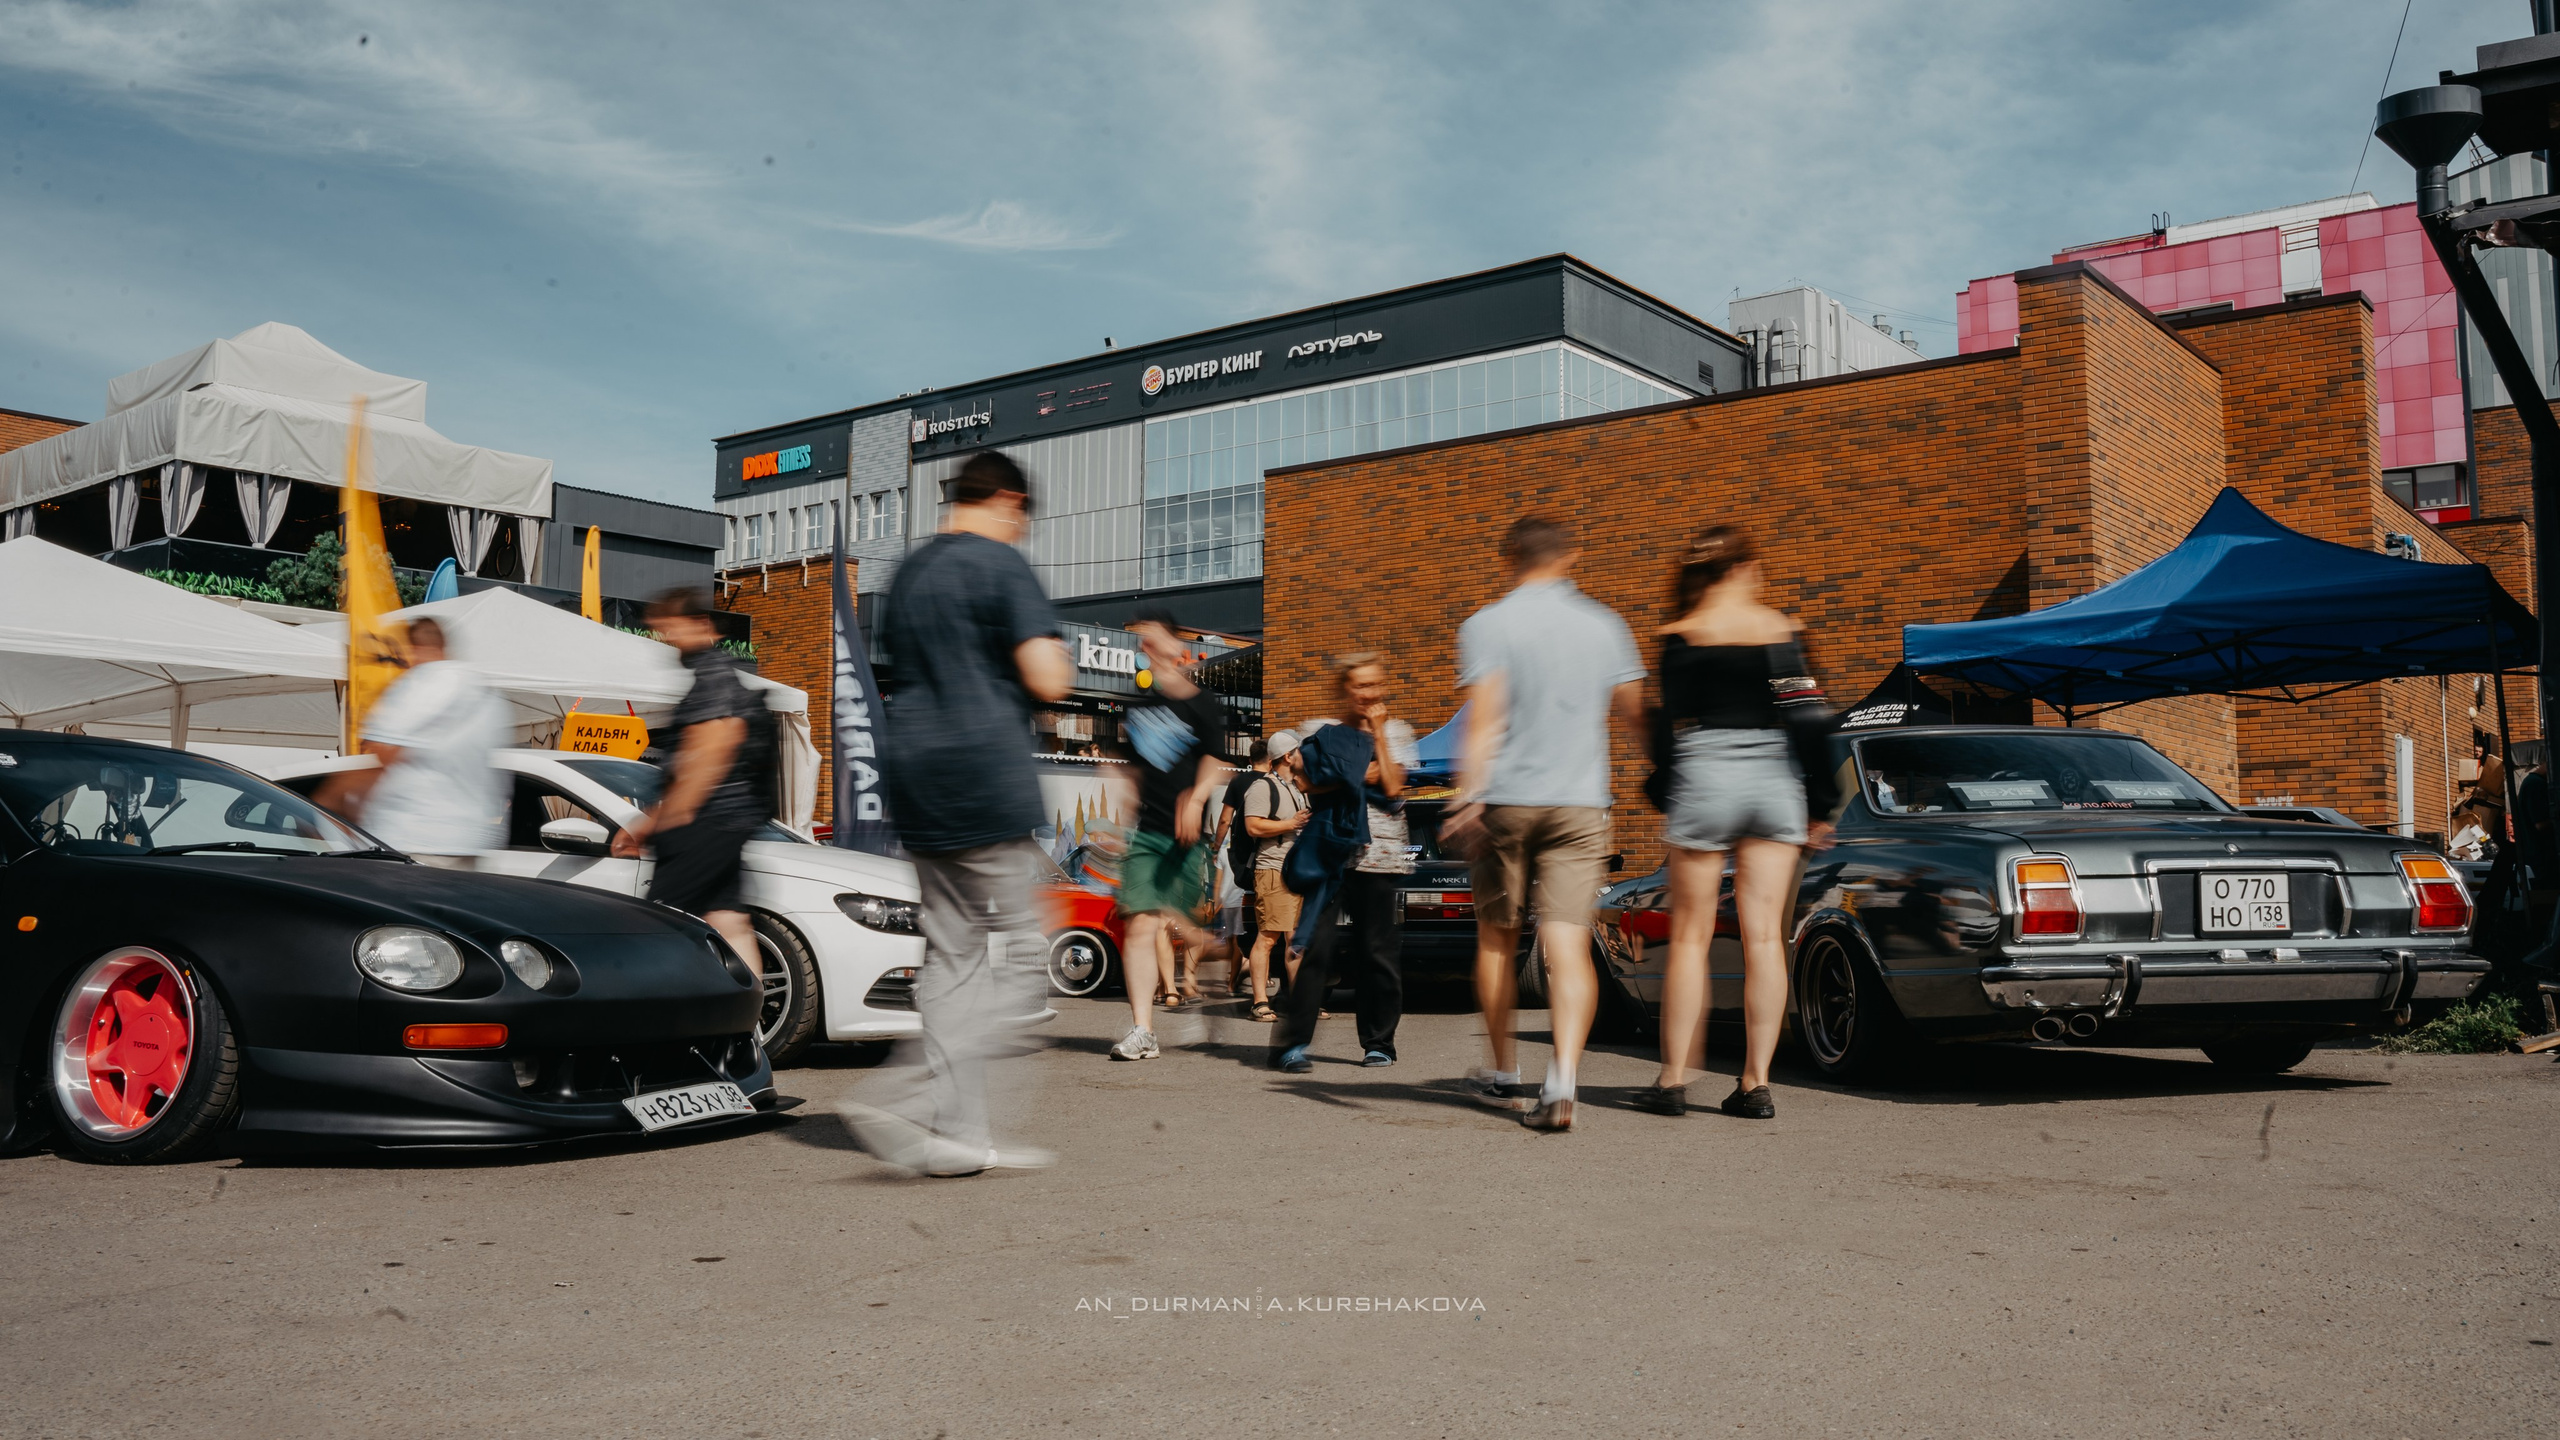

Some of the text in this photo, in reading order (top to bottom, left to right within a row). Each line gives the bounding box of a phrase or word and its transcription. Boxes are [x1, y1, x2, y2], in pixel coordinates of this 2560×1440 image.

[1166, 350, 1263, 386] БУРГЕР КИНГ
[928, 411, 991, 436] ROSTIC'S
[1840, 717, 1903, 729] КРАСИВЫМ
[1850, 711, 1905, 723] ВАШ АВТО
[576, 726, 630, 740] КАЛЬЯН
[572, 740, 609, 754] КЛАБ
[1431, 876, 1461, 884] MARK
[2237, 878, 2276, 900] 770
[2210, 906, 2243, 928] НО
[2253, 905, 2284, 922] 138
[2262, 921, 2277, 929] RUS
[133, 1041, 160, 1051] TOYOTA
[718, 1085, 743, 1103] 38
